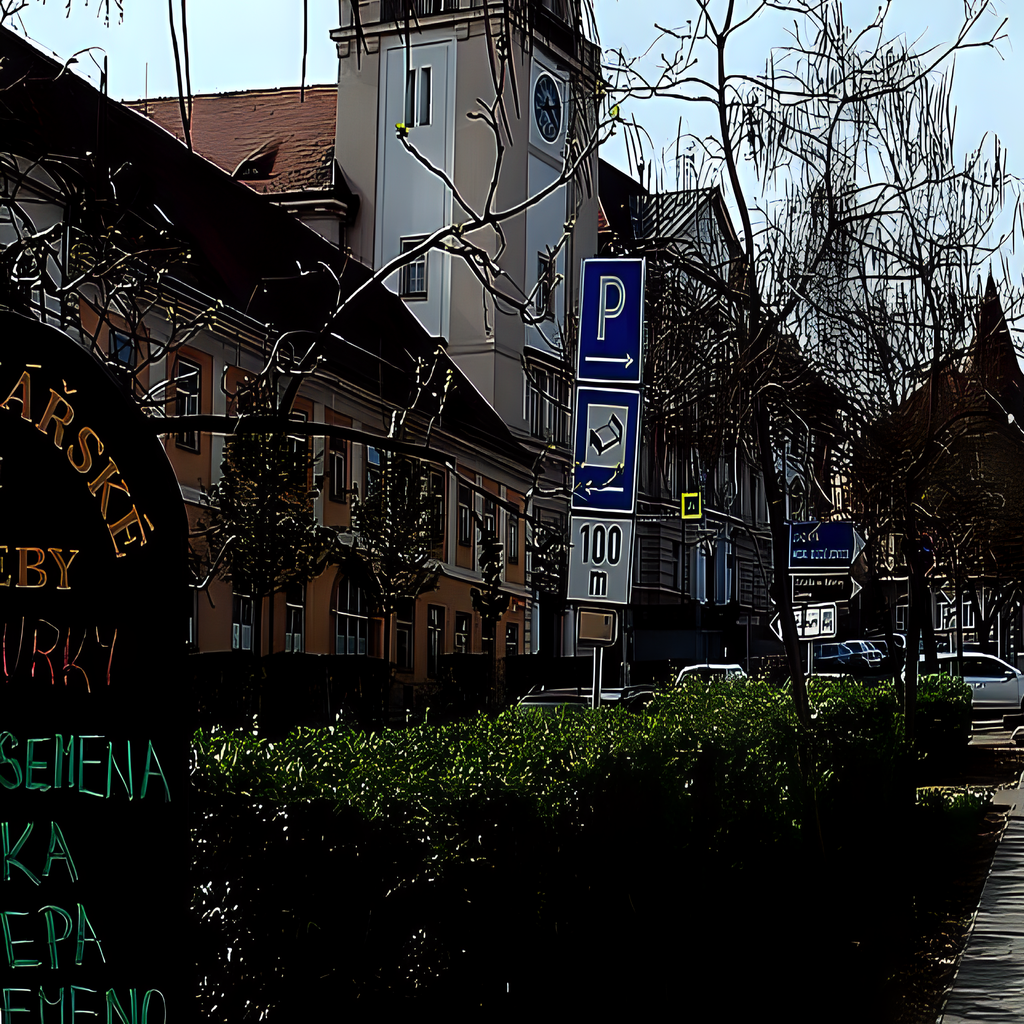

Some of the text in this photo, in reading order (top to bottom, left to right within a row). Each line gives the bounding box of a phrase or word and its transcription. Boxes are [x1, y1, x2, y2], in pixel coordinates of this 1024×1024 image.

[597, 276, 626, 341] P
[579, 522, 622, 566] 100
[588, 570, 607, 598] m
[0, 731, 171, 802] SEMENA
[1, 821, 78, 886] KA
[1, 903, 106, 969] EPA
